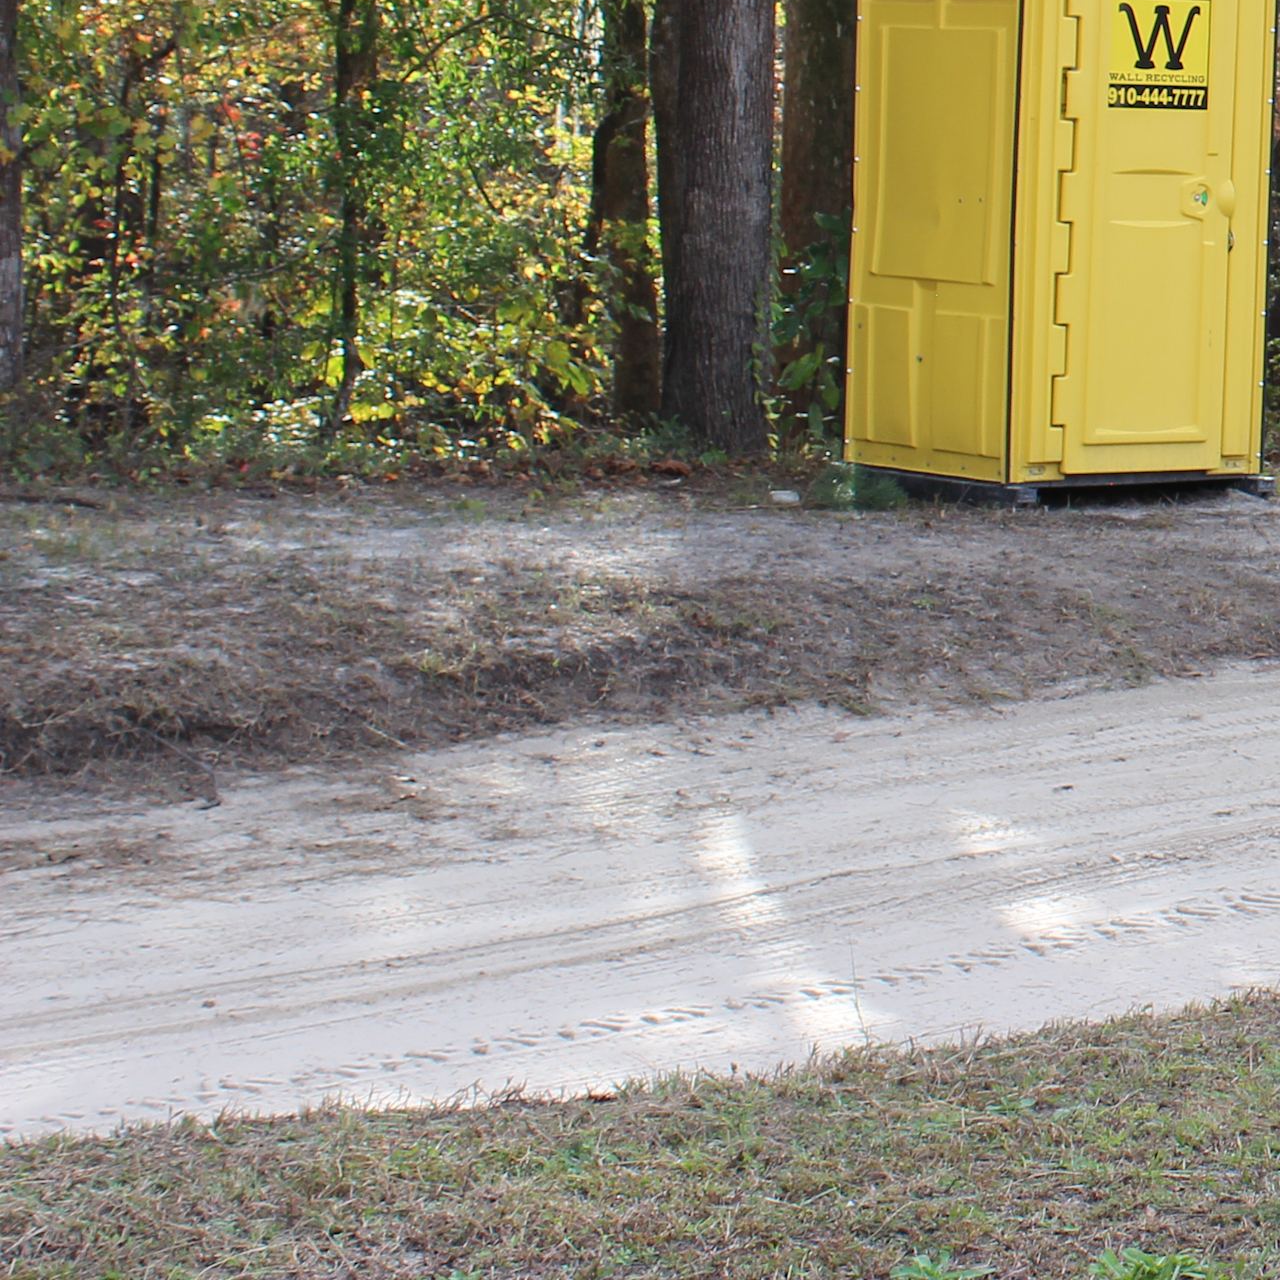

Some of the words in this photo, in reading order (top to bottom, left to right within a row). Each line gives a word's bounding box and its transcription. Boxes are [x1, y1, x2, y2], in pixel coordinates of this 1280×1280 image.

[1118, 2, 1201, 70] W
[1109, 72, 1143, 82] WALL
[1145, 73, 1205, 84] RECYCLING
[1108, 87, 1206, 106] 910-444-7777
